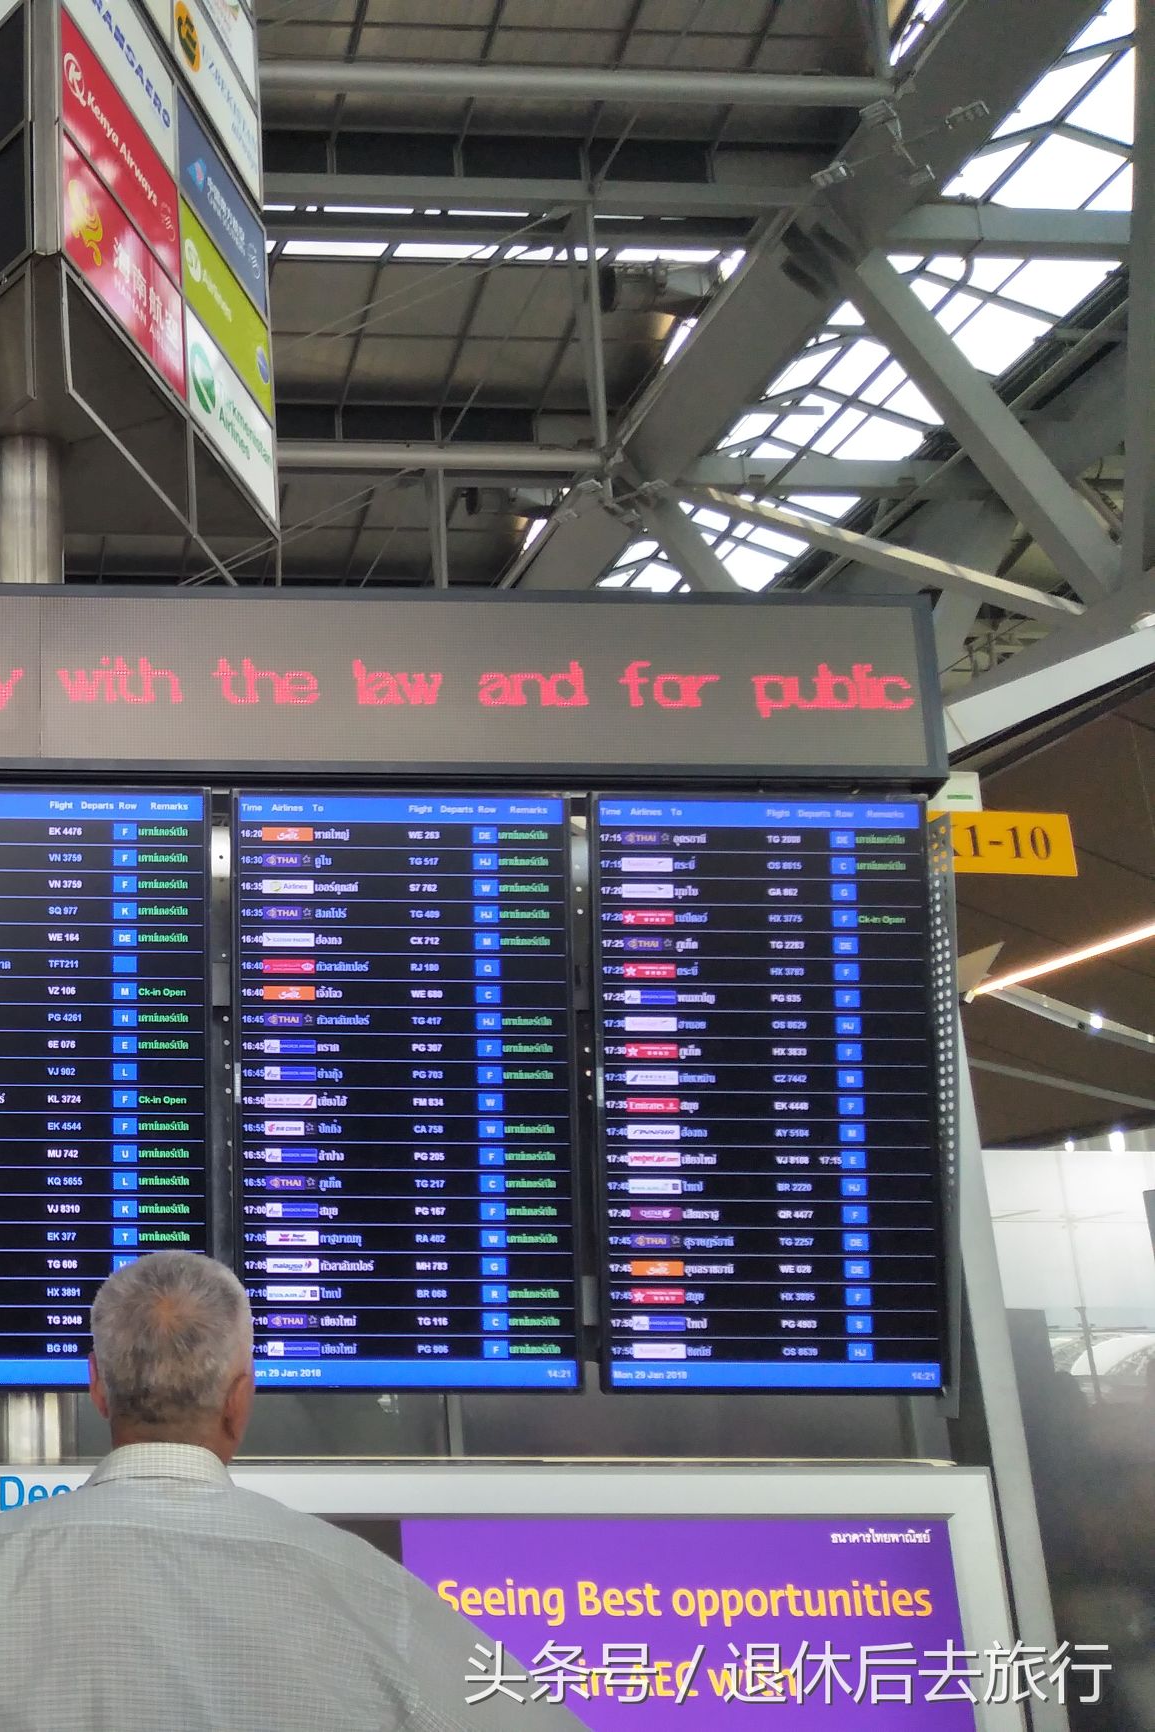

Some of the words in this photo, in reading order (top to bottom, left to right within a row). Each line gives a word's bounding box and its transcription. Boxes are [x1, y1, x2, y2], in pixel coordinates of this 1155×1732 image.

[87, 91, 119, 147] Kenya
[119, 142, 158, 207] Airways
[219, 405, 251, 461] Airlines
[57, 655, 183, 704] with
[213, 658, 321, 705] the
[353, 659, 444, 705] law
[478, 660, 589, 707] and
[618, 661, 720, 708] for
[751, 663, 915, 718] public
[49, 827, 61, 836] EK
[48, 933, 63, 942] WE
[48, 959, 78, 969] TFT211
[48, 986, 60, 995] VZ
[61, 986, 76, 996] 106
[48, 1095, 60, 1103] KL
[61, 1095, 81, 1104] 3724
[48, 1122, 61, 1130] EK
[62, 1122, 81, 1131] 4544
[47, 1149, 60, 1158] MU
[61, 1149, 78, 1158] 742
[414, 1179, 428, 1188] TG
[831, 1528, 931, 1544] ธนาคารไทยพาณิชย์
[437, 1578, 566, 1626] Seeing
[577, 1581, 662, 1617] Best
[673, 1581, 933, 1628] opportunities
